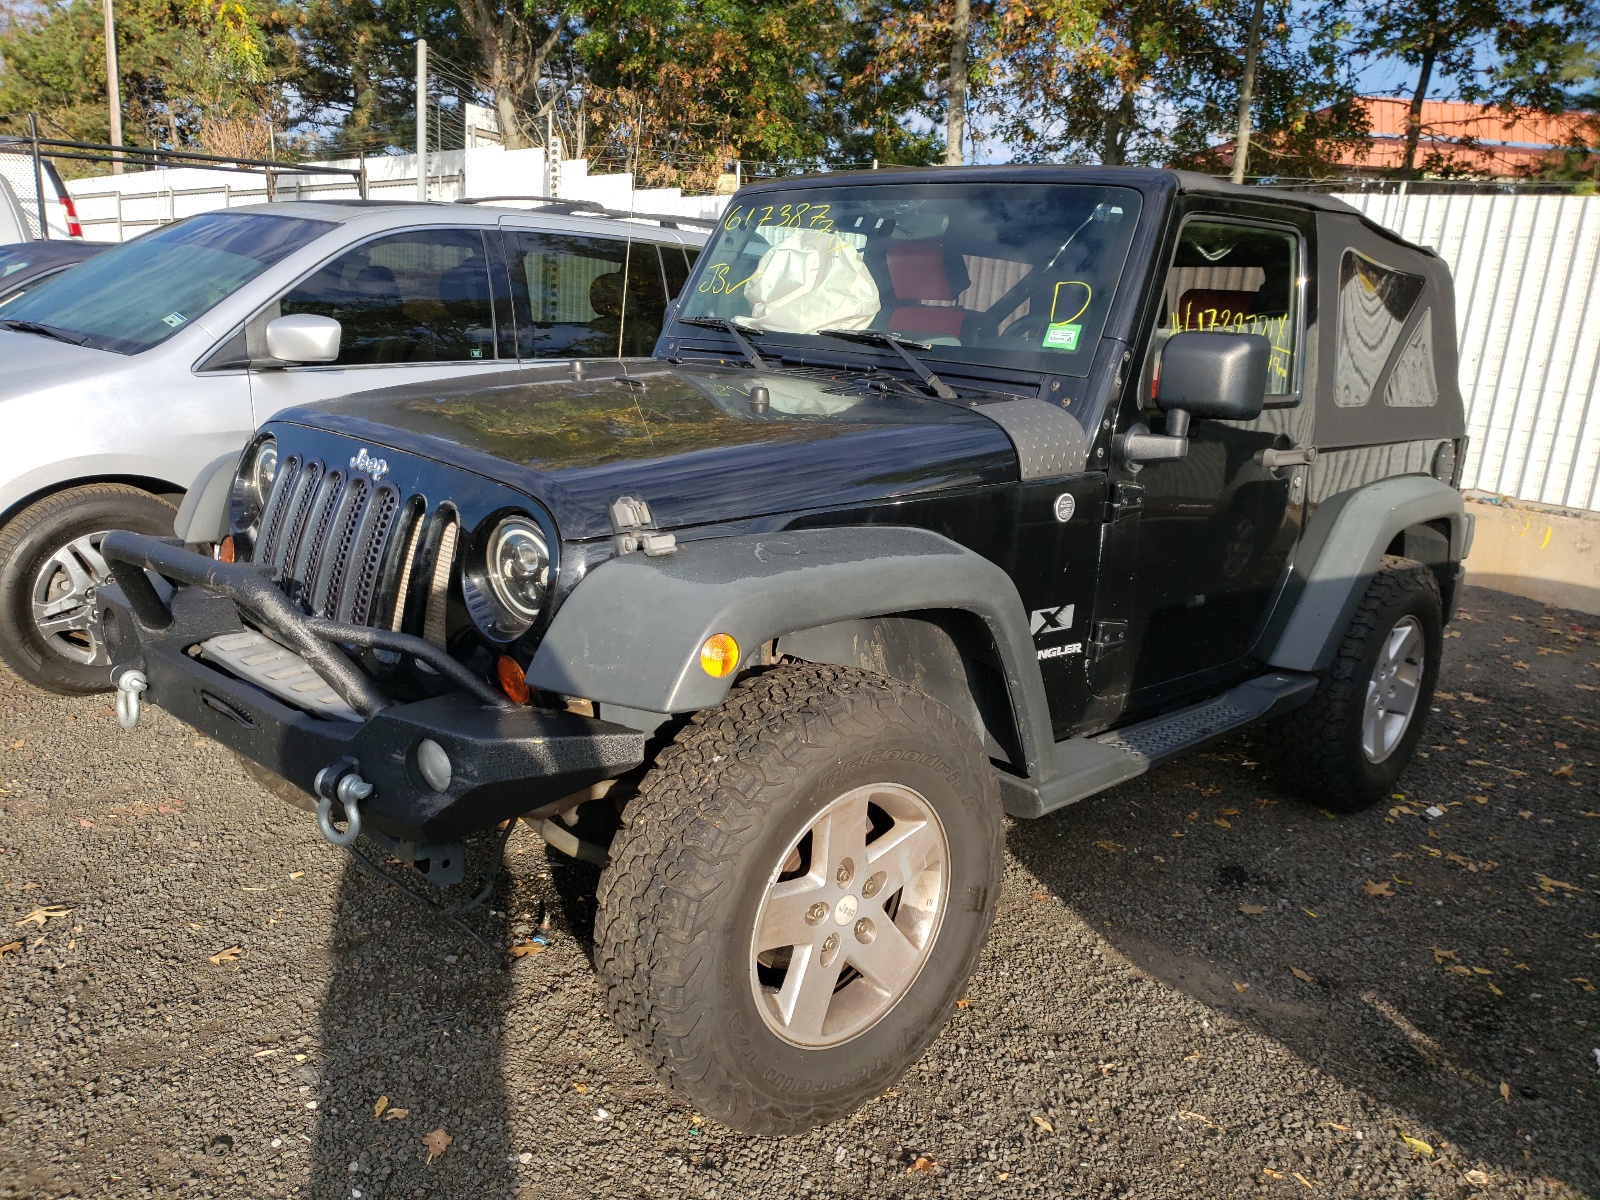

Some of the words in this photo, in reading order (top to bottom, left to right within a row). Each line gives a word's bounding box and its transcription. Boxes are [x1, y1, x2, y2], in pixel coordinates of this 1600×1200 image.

[1050, 281, 1092, 327] D
[349, 447, 389, 481] Jeep
[1036, 642, 1082, 660] NGLER
